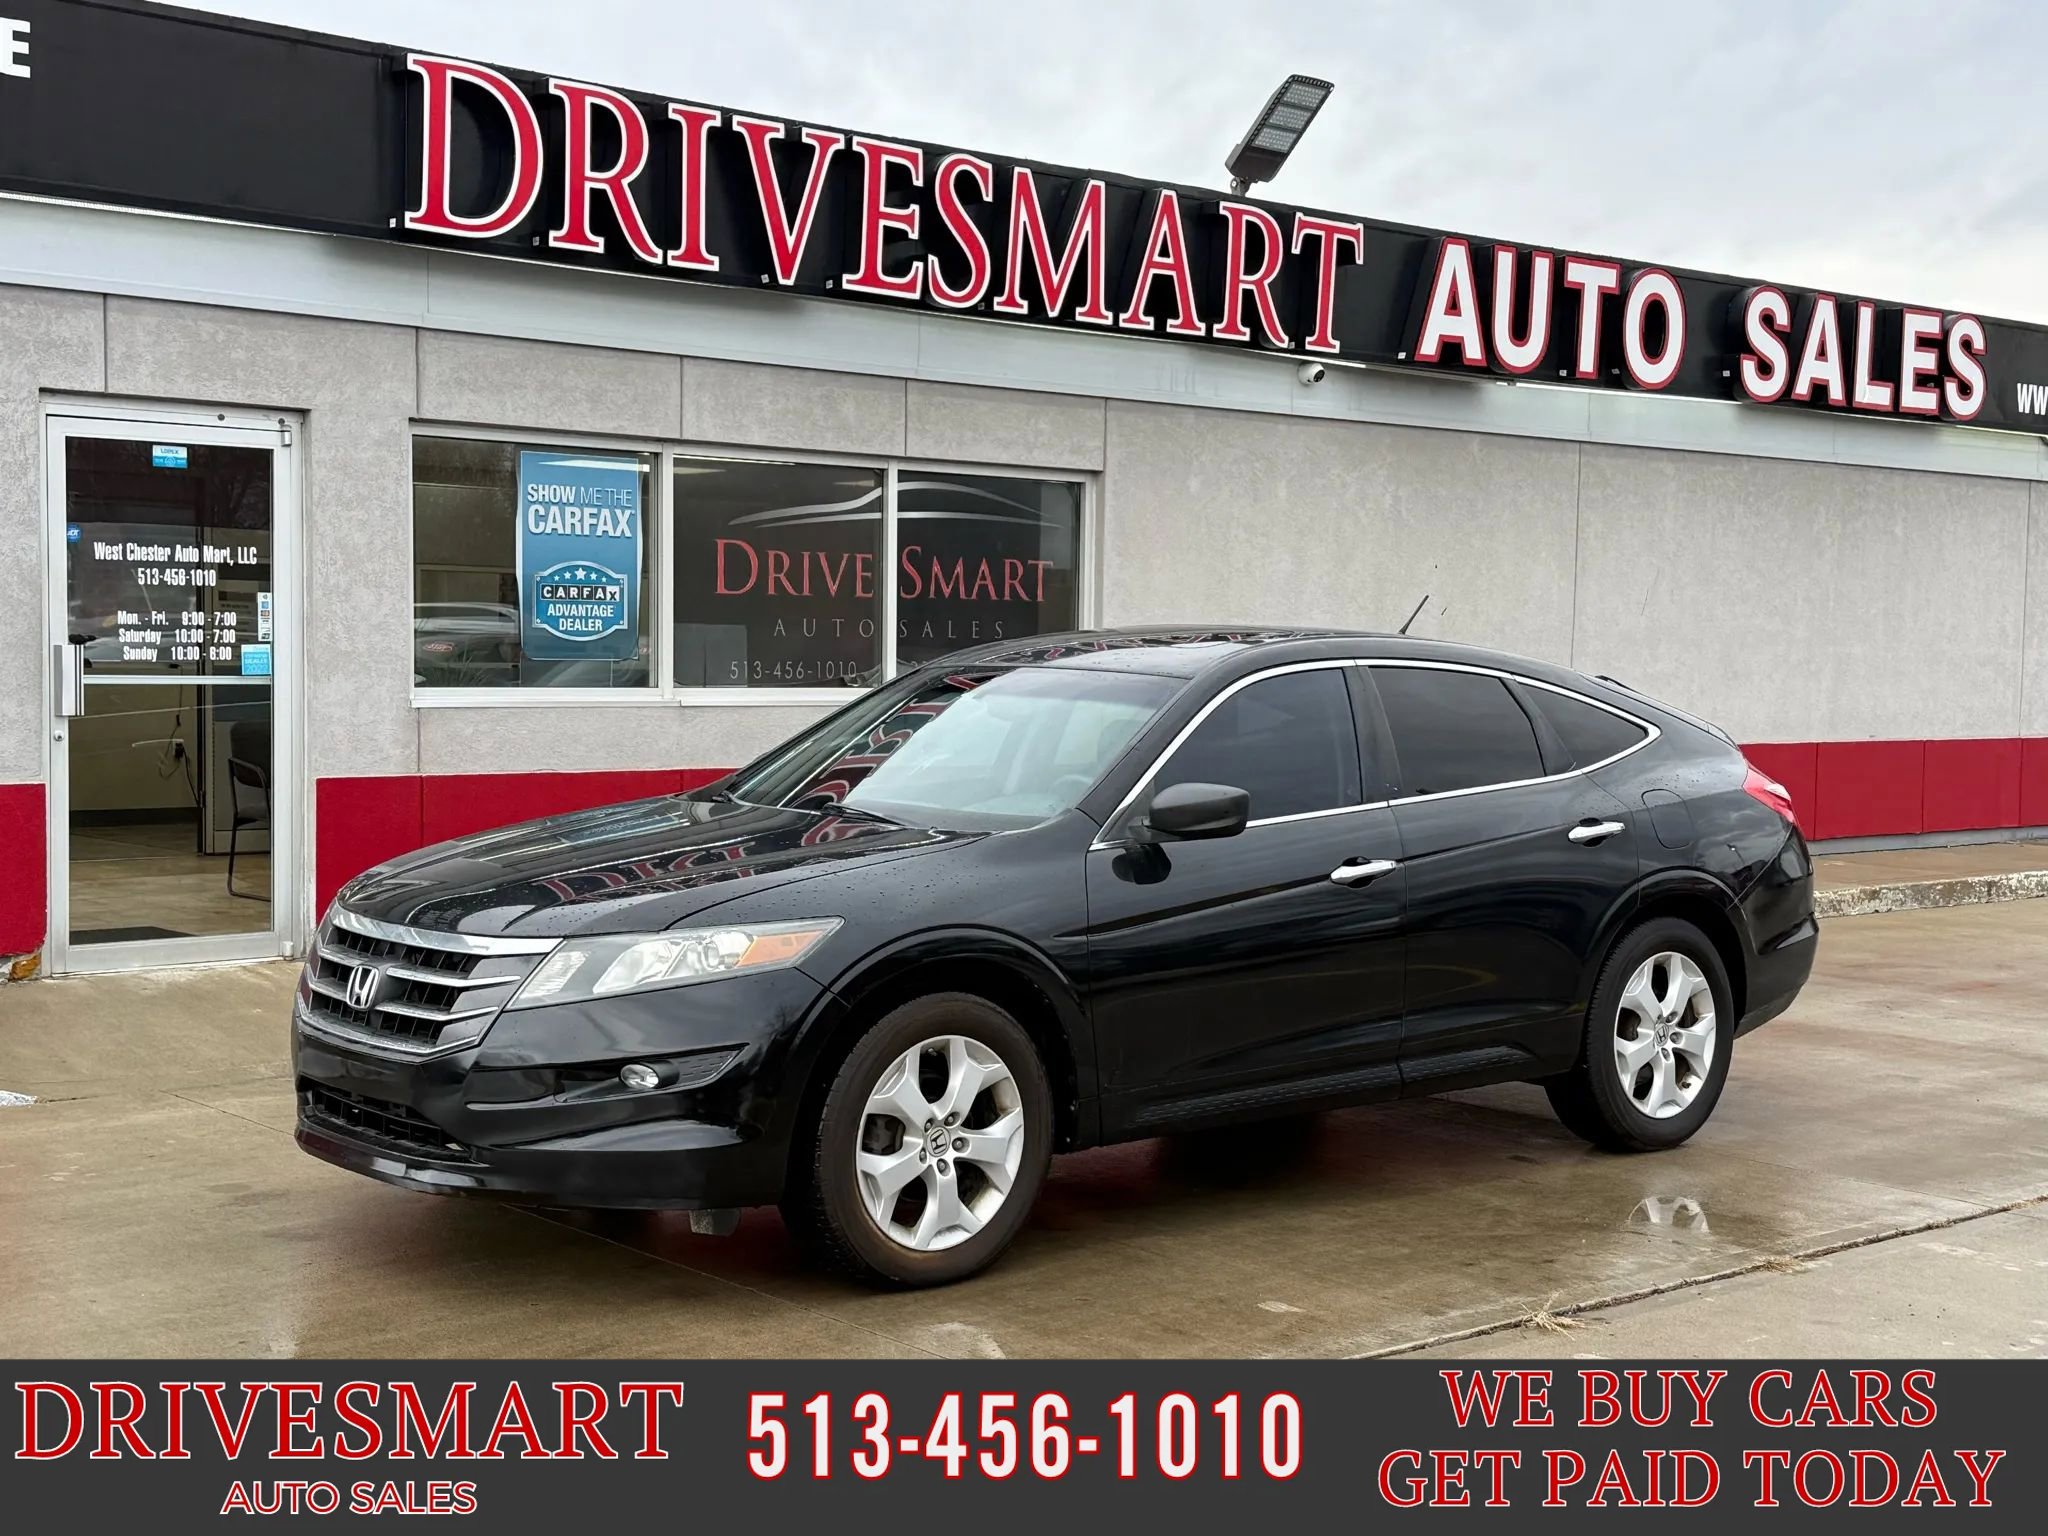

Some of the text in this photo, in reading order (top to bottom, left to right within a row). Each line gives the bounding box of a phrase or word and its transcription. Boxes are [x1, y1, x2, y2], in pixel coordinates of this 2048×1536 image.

[404, 52, 1364, 354] DRIVESMART
[1414, 236, 1987, 421] AUTO SALES
[527, 483, 632, 507] SHOW ME THE
[527, 504, 634, 538] CARFAX
[94, 542, 257, 566] West Chester Auto Mart, LLC
[137, 567, 217, 587] 513-456-1010
[714, 538, 1054, 602] DRIVE SMART
[542, 585, 618, 601] CARFAX
[117, 610, 142, 626] Mon.
[151, 610, 169, 626] Fri.
[213, 611, 237, 626] 7:00
[547, 603, 614, 618] ADVANTAGE
[559, 618, 603, 631] DEALER
[774, 618, 1004, 639] AUTO SALES
[118, 627, 162, 645] Saturday
[174, 628, 204, 643] 10:00
[212, 628, 236, 643] 7:00
[123, 645, 158, 662] Sunday
[171, 646, 200, 661] 10:00
[730, 660, 857, 679] 513-456-1010
